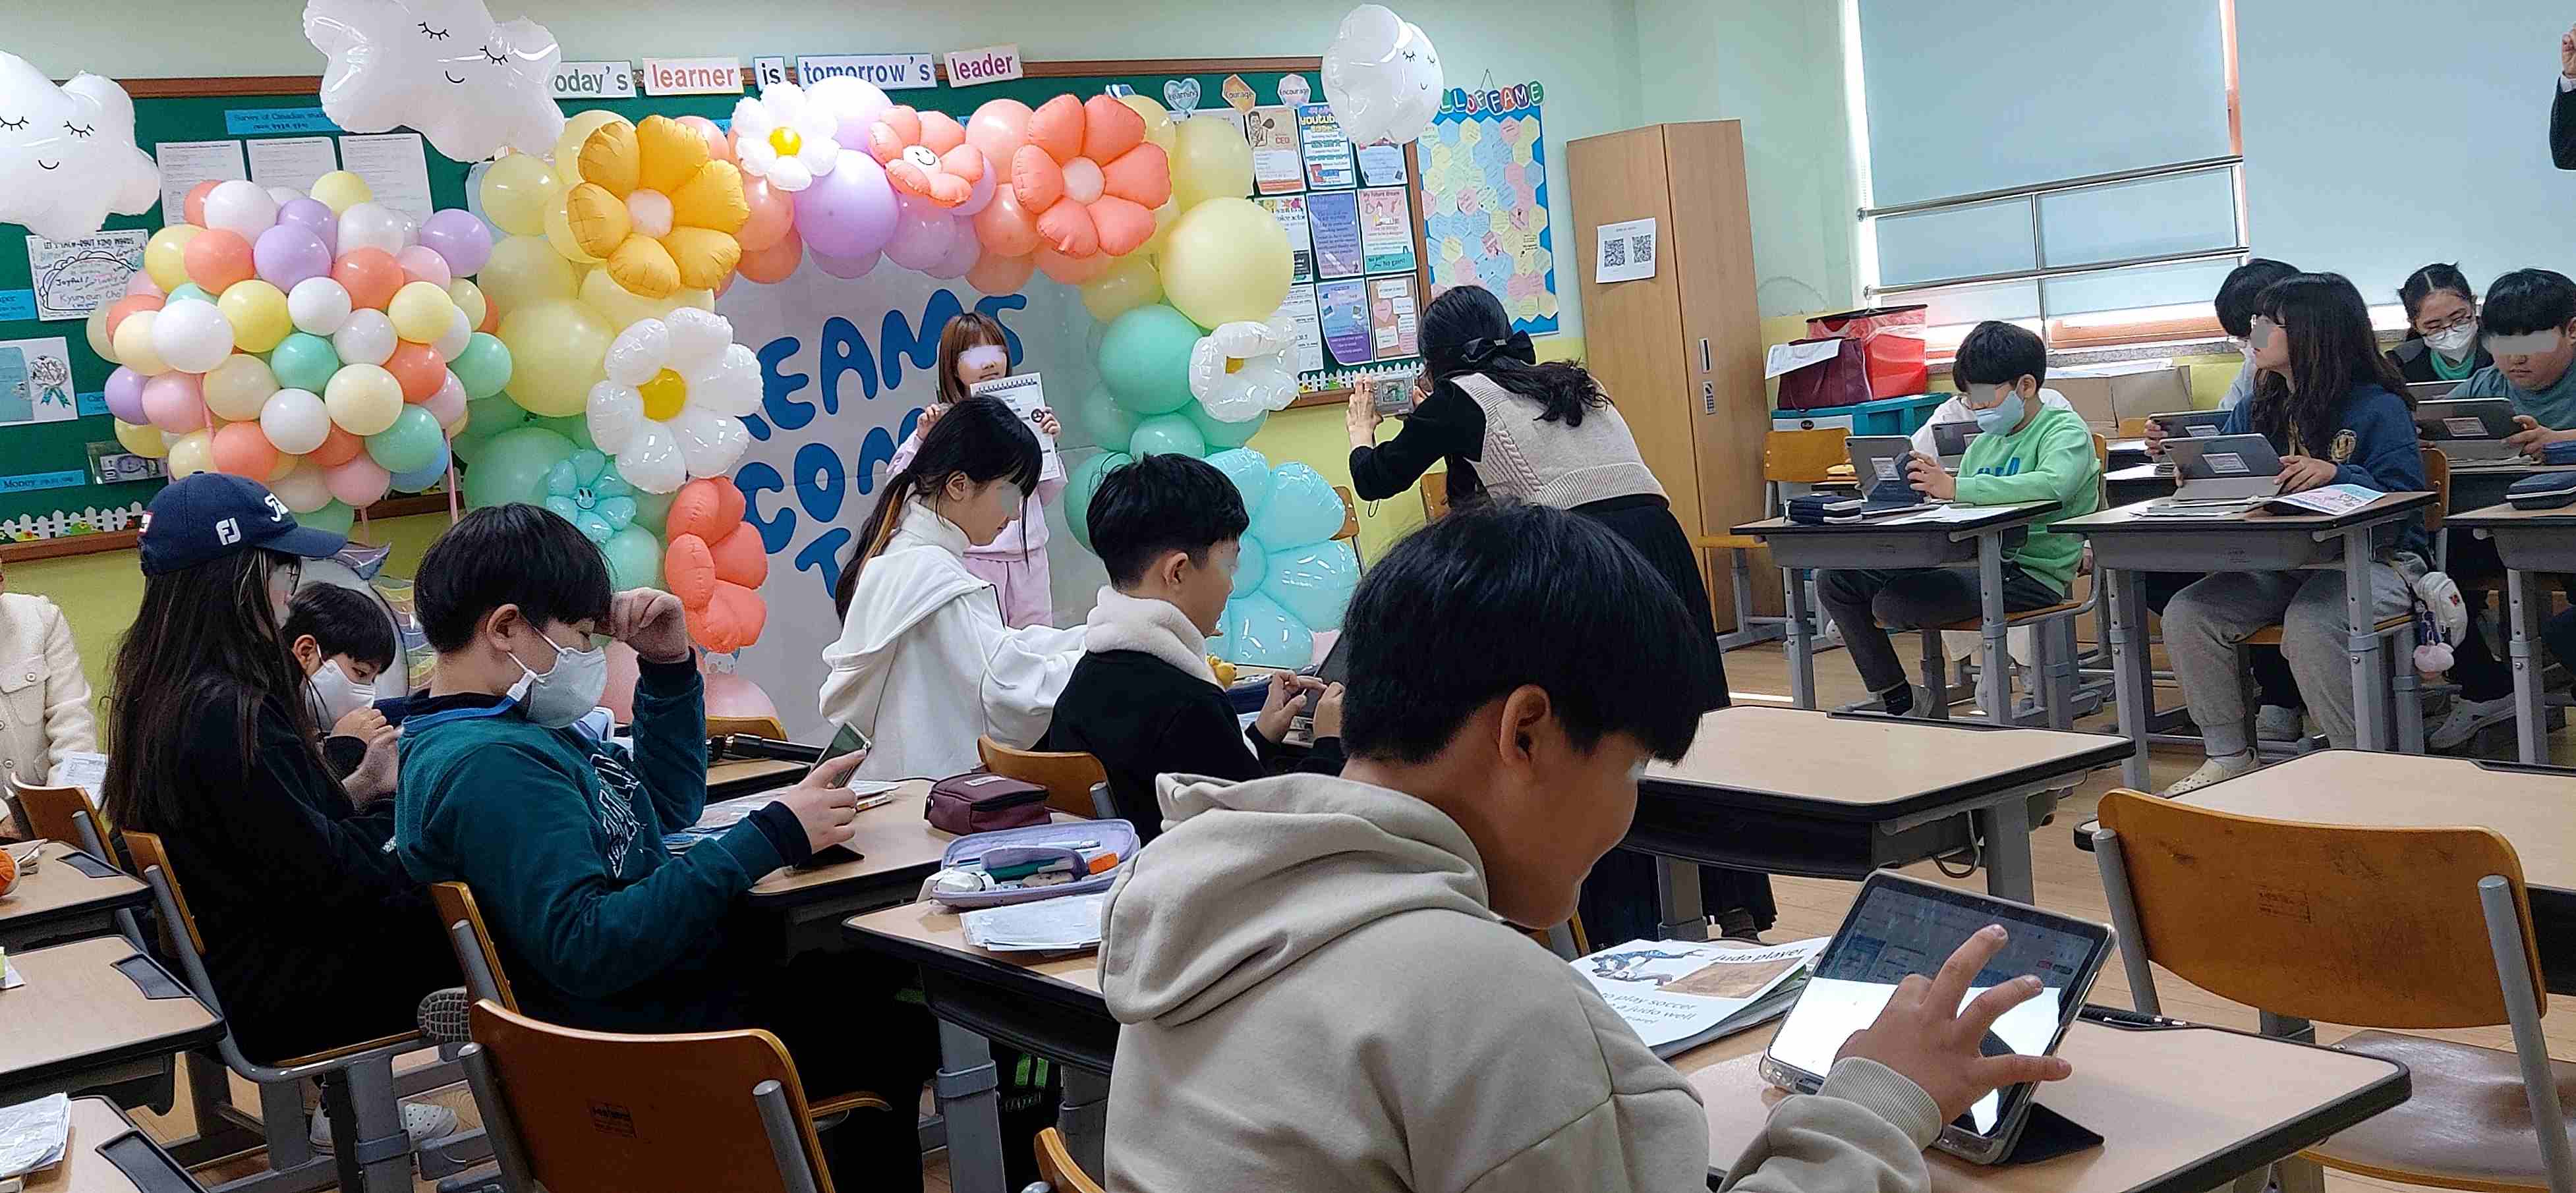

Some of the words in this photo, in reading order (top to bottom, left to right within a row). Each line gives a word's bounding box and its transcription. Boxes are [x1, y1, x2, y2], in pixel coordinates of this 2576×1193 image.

[554, 66, 628, 94] oday's
[652, 64, 734, 90] learner
[761, 63, 781, 84] is
[952, 53, 1013, 80] leader
[1441, 89, 1466, 109] LL
[1468, 91, 1485, 111] OF
[1489, 80, 1541, 112] FAME
[1301, 113, 1335, 125] youtub
[215, 518, 242, 546] FJ
[1752, 947, 1808, 962] player
[1614, 995, 1649, 1005] play
[1648, 1000, 1698, 1010] soccer
